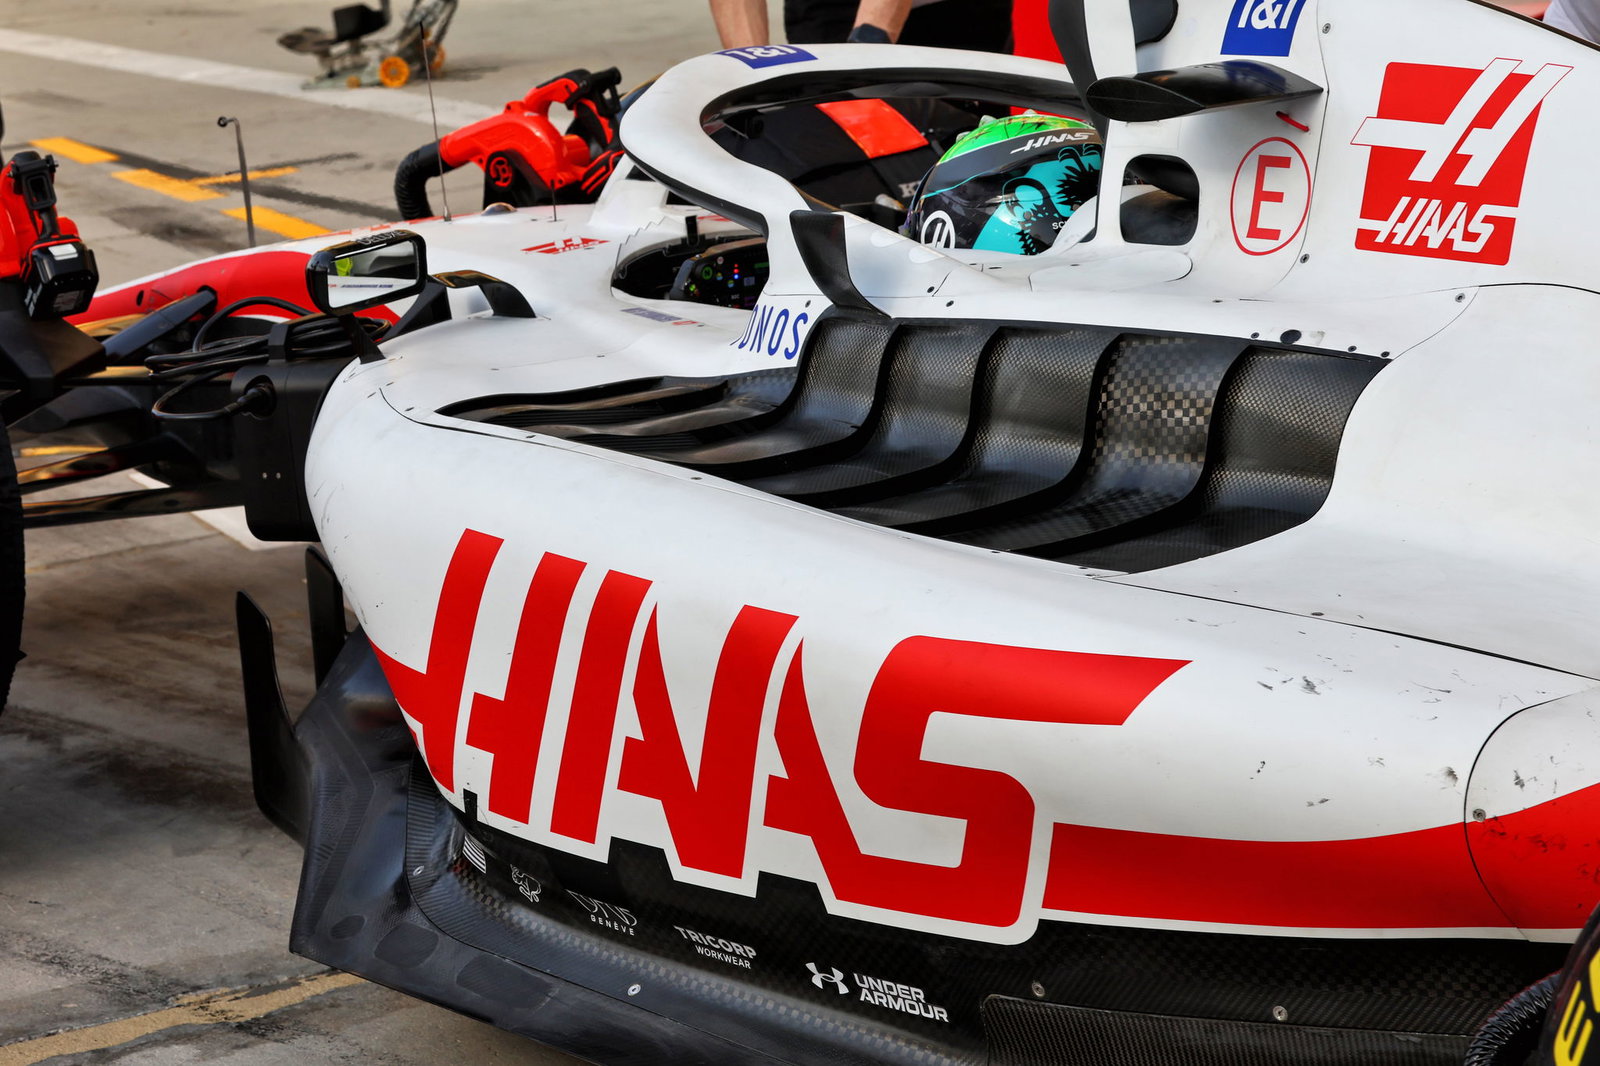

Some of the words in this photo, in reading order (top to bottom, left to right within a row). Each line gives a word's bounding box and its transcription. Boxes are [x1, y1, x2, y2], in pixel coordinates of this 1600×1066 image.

[1010, 132, 1095, 154] HAAS
[1246, 154, 1291, 240] E
[1357, 196, 1518, 253] HAAS
[368, 527, 1193, 928] HAAS
[673, 925, 757, 959] TRICORP
[695, 945, 751, 969] WORKWEAR
[854, 972, 926, 1003] UNDER
[860, 989, 949, 1022] ARMOUR
